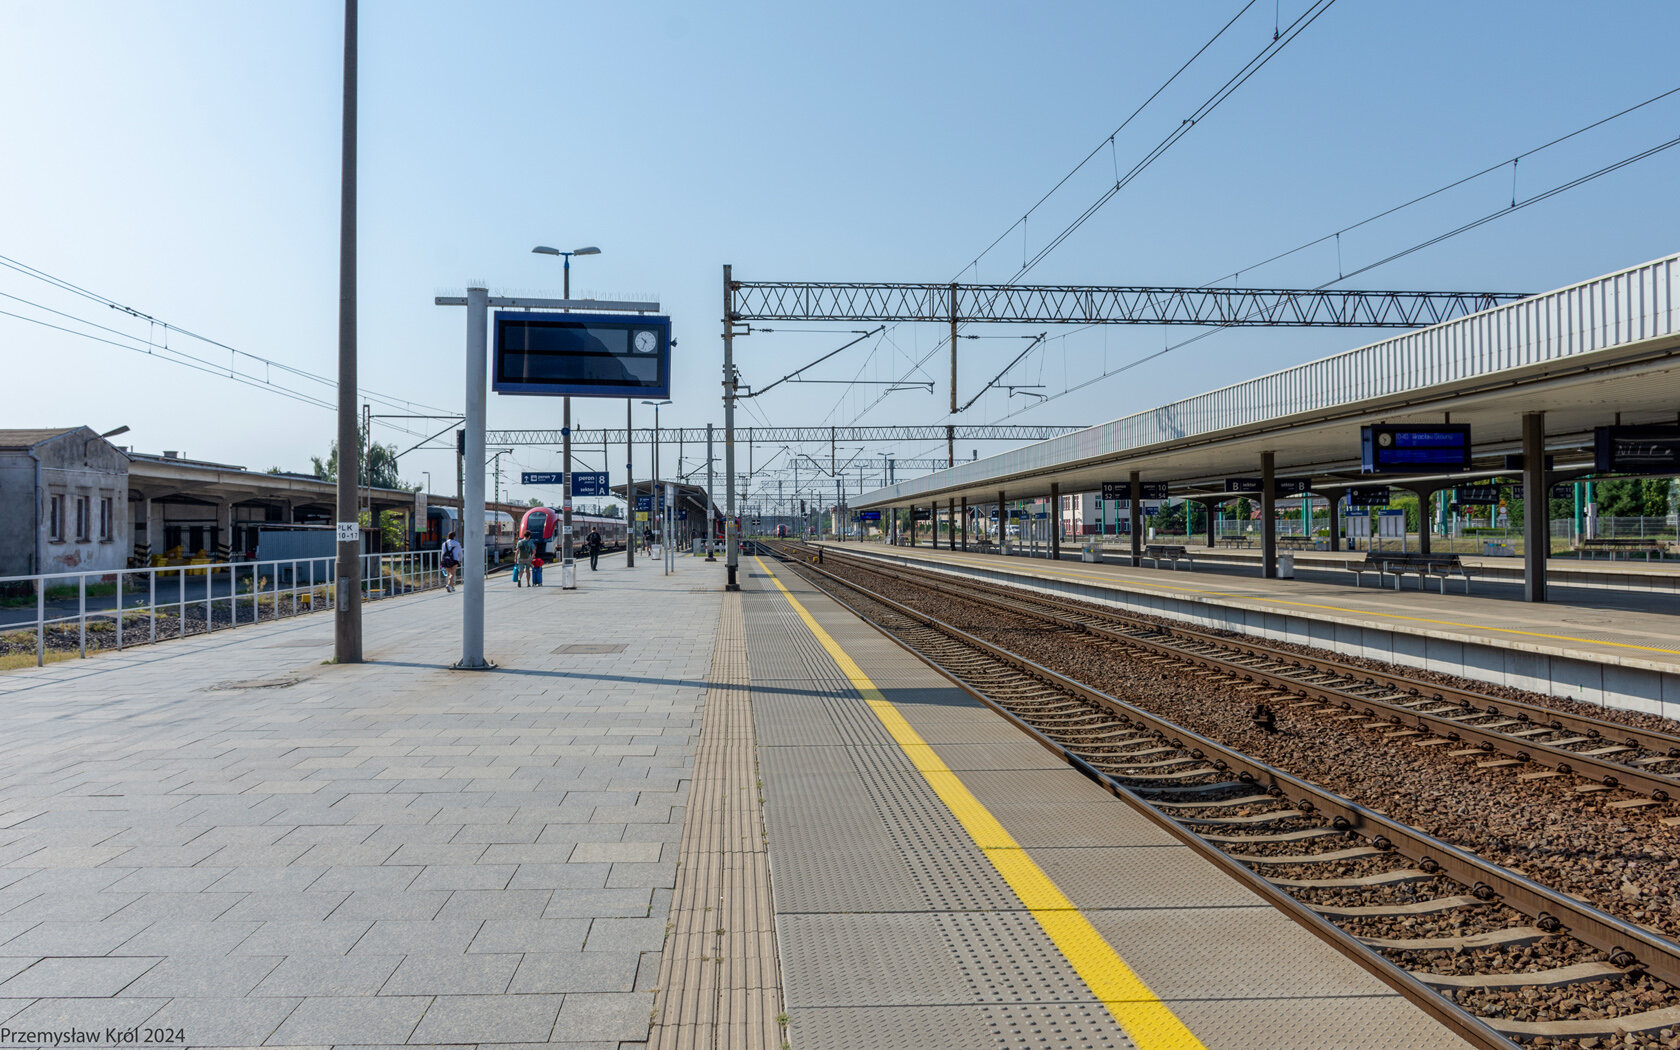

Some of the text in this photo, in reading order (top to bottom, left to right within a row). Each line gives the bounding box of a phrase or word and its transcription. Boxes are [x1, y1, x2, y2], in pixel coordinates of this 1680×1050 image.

[599, 475, 605, 484] 8
[1232, 481, 1239, 490] B
[1298, 481, 1305, 490] B
[599, 487, 605, 495] A
